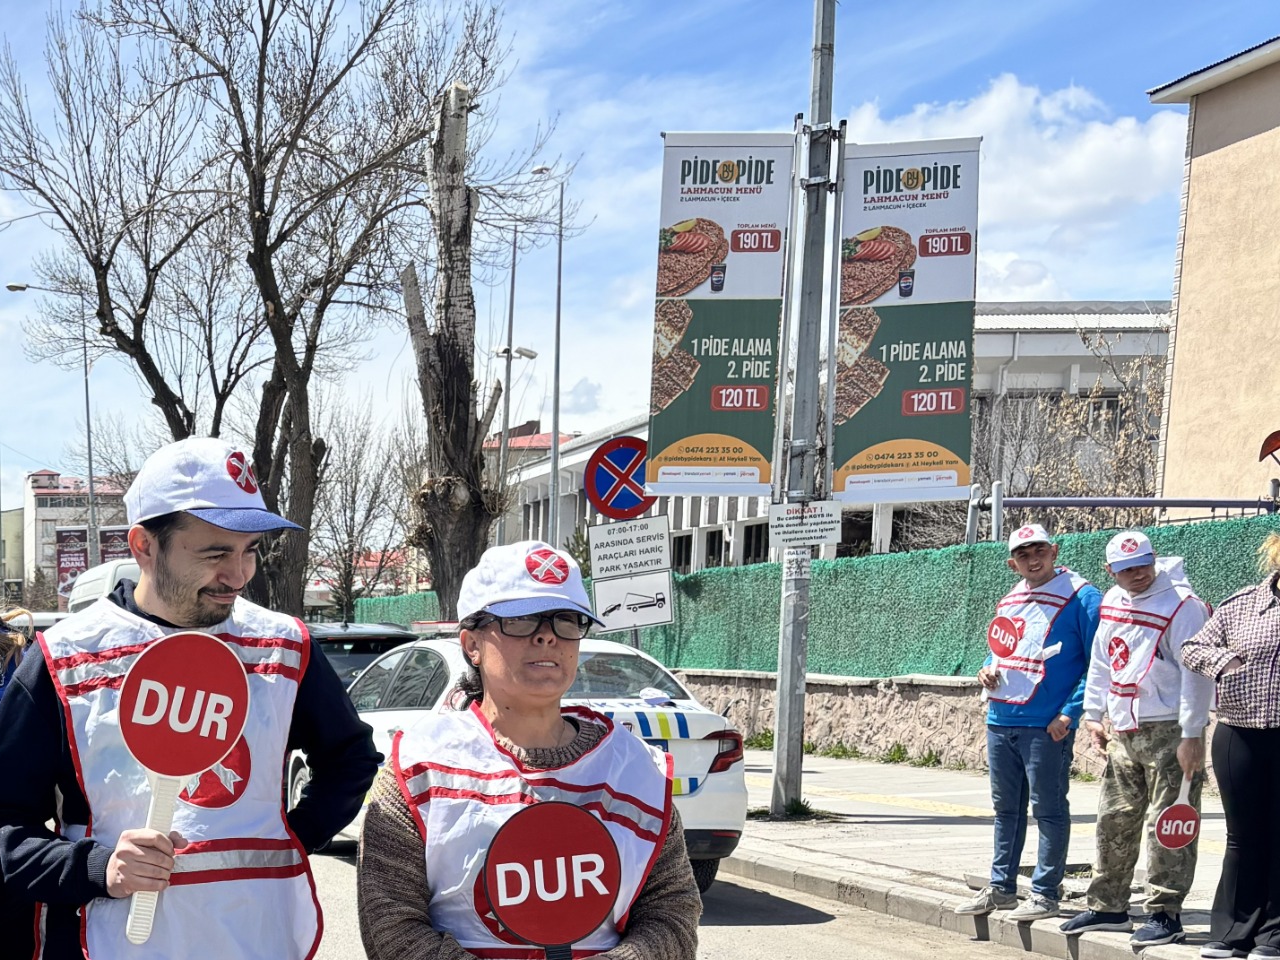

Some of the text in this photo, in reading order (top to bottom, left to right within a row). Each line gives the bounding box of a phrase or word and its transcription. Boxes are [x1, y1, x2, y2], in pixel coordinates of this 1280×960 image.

[680, 155, 775, 185] PİDE BY PİDE
[863, 162, 961, 195] PİDE BY PİDE
[681, 185, 762, 195] LAHMACUN MENÜ
[863, 191, 950, 204] LAHMACUN MENÜ
[868, 203, 901, 211] LAHMACUN
[738, 232, 774, 249] 190 TL
[926, 236, 964, 254] 190 TL
[691, 334, 773, 356] 1 PİDE ALANA
[879, 340, 967, 362] 1 PİDE ALANA
[727, 357, 771, 379] 2. PİDE
[919, 360, 966, 383] 2. PİDE
[719, 388, 761, 407] 120 TL
[910, 391, 956, 412] 120 TL
[685, 446, 744, 454] 0474 223 35 00
[874, 453, 895, 461] 0474
[897, 452, 912, 460] 223
[926, 450, 939, 458] 00
[607, 523, 649, 536] 07:00-17:00
[594, 532, 665, 550] ARASINDA SERVİS
[597, 544, 664, 562] ARAÇLARI HARİÇ
[599, 558, 662, 574] PARK YASAKTIR
[991, 623, 1016, 651] DUR
[131, 678, 235, 741] DUR
[1161, 819, 1196, 836] DUR
[495, 852, 610, 907] DUR
